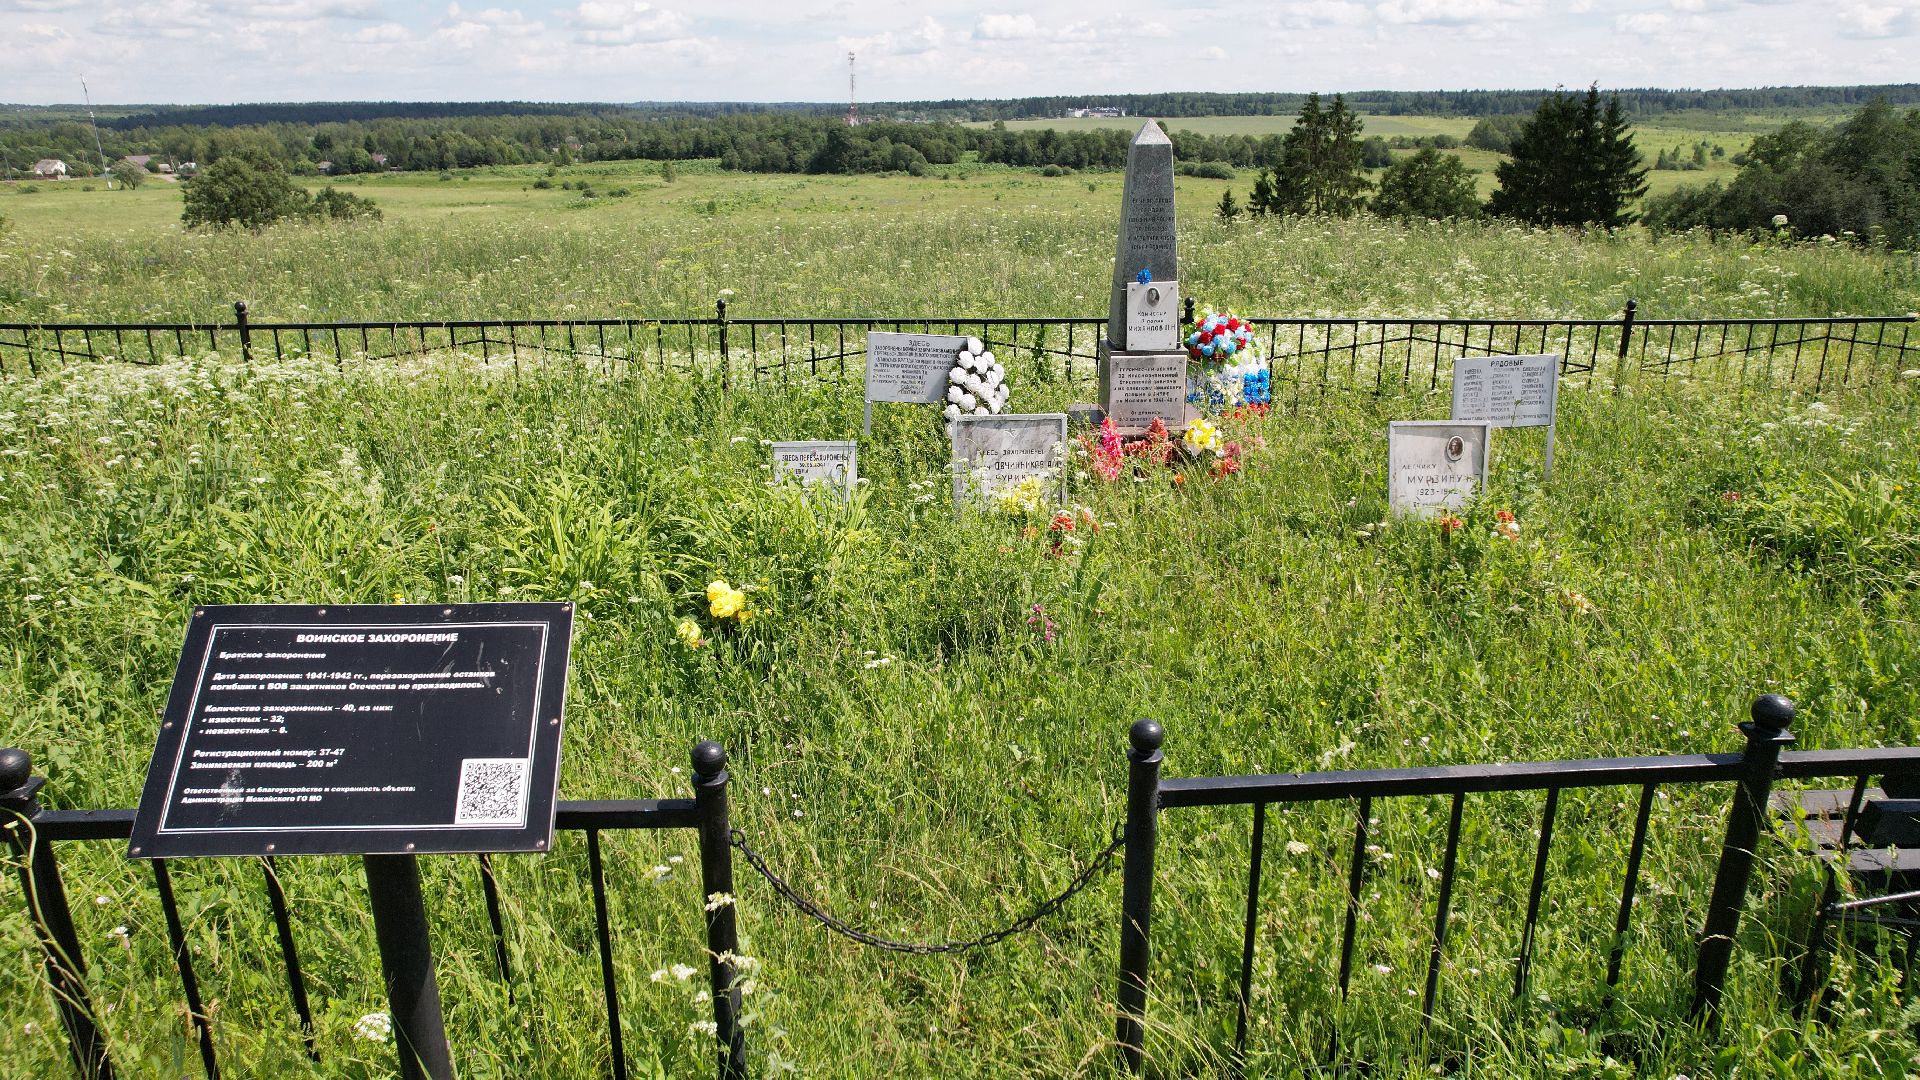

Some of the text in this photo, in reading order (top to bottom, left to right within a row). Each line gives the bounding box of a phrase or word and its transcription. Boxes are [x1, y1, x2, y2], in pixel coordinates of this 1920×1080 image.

[1490, 360, 1524, 368] РЯДОВЫЕ
[781, 454, 799, 462] ЗДЕСЬ
[1407, 474, 1463, 484] МУРЗИНУ
[296, 633, 459, 643] ВОИНСКОЕ ЗАХОРОНЕНИЕ
[219, 652, 327, 660] Братское захоронение
[212, 672, 236, 681] Дата
[237, 673, 303, 681] захоронения:
[305, 672, 352, 680] 1941-1942
[369, 672, 451, 681] перезахоронение
[453, 671, 496, 679] останков
[210, 683, 257, 691] погибших
[258, 683, 265, 691] в
[289, 684, 347, 692] защитников
[348, 682, 396, 691] Отечества
[397, 683, 411, 691] не
[412, 682, 485, 691] производилось.
[204, 704, 261, 713] Количество
[262, 705, 333, 713] захороненных
[341, 704, 357, 713] 40,
[372, 704, 393, 712] них:
[208, 716, 262, 724] известных
[270, 715, 285, 724] 32;
[204, 727, 270, 735] неизвестных
[193, 748, 346, 758] Регистрационный номер: 37-47
[190, 761, 252, 770] Занимаемая
[253, 760, 297, 770] площадь
[305, 759, 324, 769] 200
[183, 787, 245, 795] Ответственный
[256, 786, 323, 795] благоустройство
[381, 785, 416, 793] объекта:
[245, 795, 295, 804] Можайского
[296, 795, 309, 803] ГО
[309, 795, 323, 803] МО
